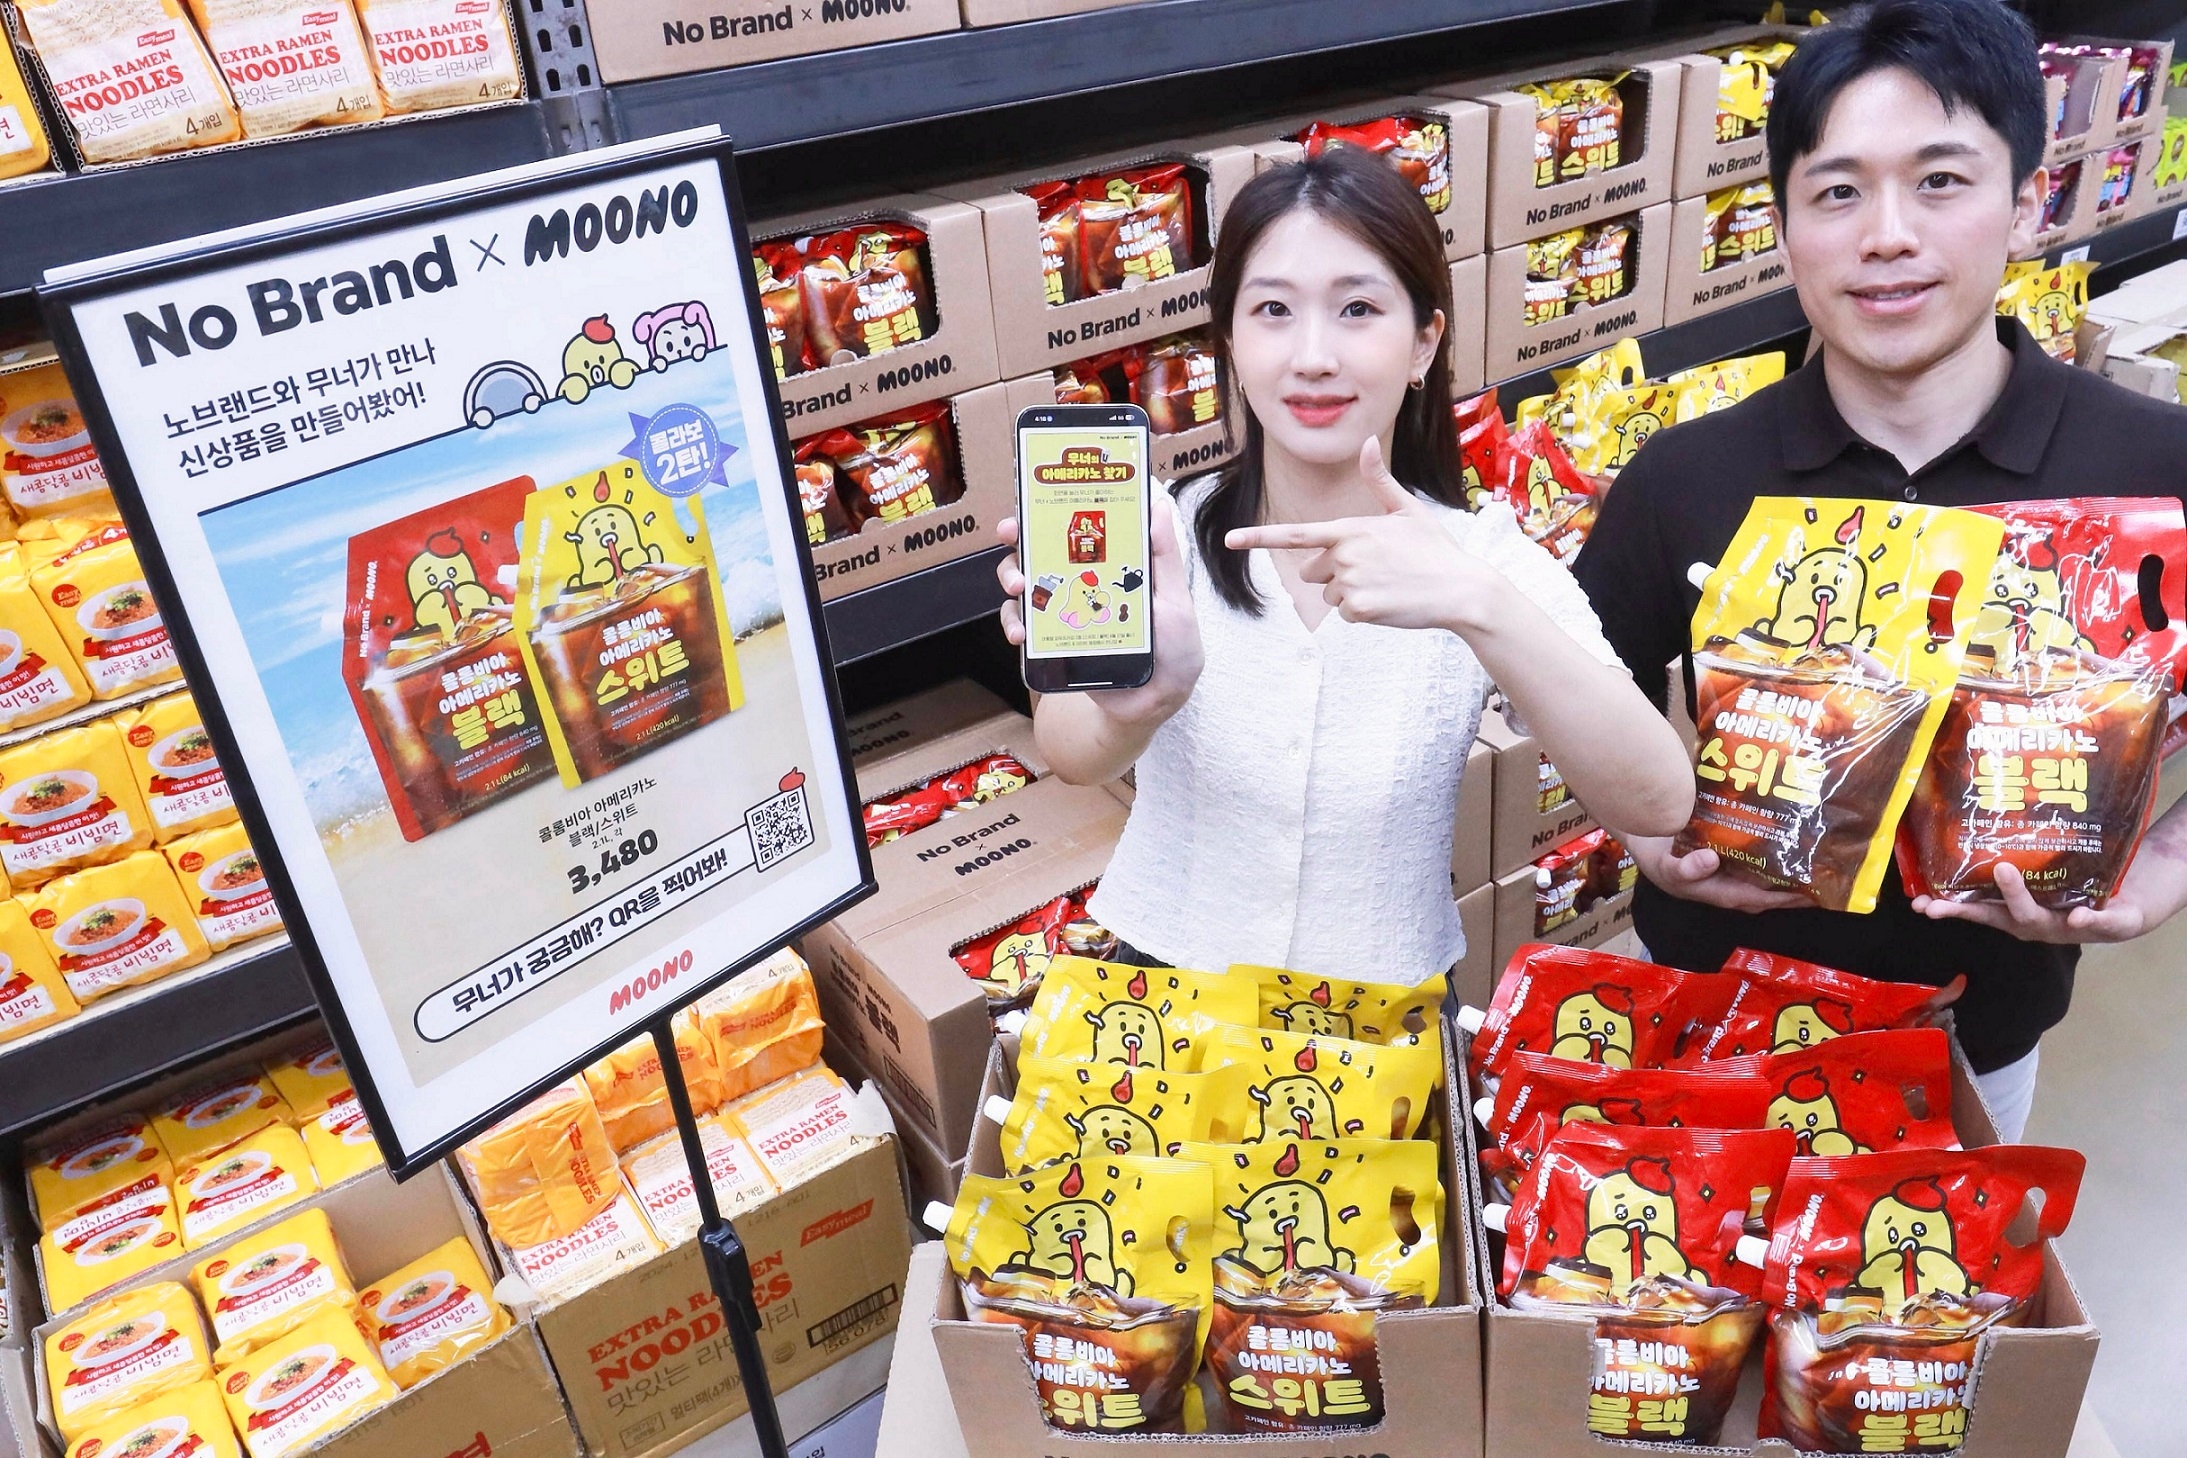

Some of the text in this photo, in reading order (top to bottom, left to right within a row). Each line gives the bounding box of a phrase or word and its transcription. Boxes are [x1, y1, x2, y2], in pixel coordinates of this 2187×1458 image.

[375, 19, 483, 45] EXTRA RAMEN
[663, 0, 907, 46] No Brand MOONO
[219, 30, 333, 64] EXTRA RAMEN
[225, 45, 341, 86] NOODLES
[380, 34, 489, 67] NOODLES
[54, 49, 173, 97] EXTRA RAMEN
[234, 67, 351, 109] 맛있는 라면사리
[385, 54, 495, 88] 맛있는 라면사리
[63, 65, 185, 119] NOODLES
[76, 86, 197, 140] 맛있는 라면사리
[1560, 143, 1620, 176] 스위트
[1707, 151, 1763, 177] No Brand
[1526, 178, 1646, 225] No Brand MOONO
[1719, 225, 1775, 255] 스위트
[123, 180, 698, 367] No Brand MOONO
[857, 271, 907, 303] 콜롬비아
[1572, 272, 1624, 300] 스위트
[1693, 275, 1746, 305] No Brand
[853, 290, 916, 322] 아메리카노
[1048, 287, 1211, 349] No Brand MOON
[864, 307, 922, 355] 블랙
[1518, 312, 1637, 361] No Brand MOONO
[163, 338, 436, 440] 노브랜드와 무너가 만나
[782, 354, 952, 419] Brand MOONO
[178, 381, 427, 480] 신상품을 만들어봤어!
[650, 418, 704, 447] 콜라보
[656, 443, 711, 486] 2탄!
[1042, 466, 1127, 481] 아메리카노 찾기
[1067, 452, 1099, 465] 무너의
[20, 474, 70, 493] 새콤달콤
[869, 468, 930, 504] 아메리카노
[815, 515, 975, 580] Brand MOONO
[359, 561, 377, 657] No Brand MOONO
[602, 608, 662, 646] 콜롬비아
[102, 656, 149, 677] 새콤달콤
[599, 627, 674, 667] 아메리카노
[439, 671, 522, 714] 아메리카노
[441, 652, 508, 693] 콜롬비아
[597, 639, 690, 706] 스위트
[452, 689, 525, 750] 블랙
[1735, 688, 1826, 727] 콜롬비아
[1715, 711, 1822, 752] 아메리카노
[1967, 728, 2099, 752] 아메리카노
[1697, 737, 1827, 806] 스위트
[1972, 756, 2089, 813] 블랙
[163, 794, 210, 813] 새콤달콤
[538, 777, 658, 843] 콜롬비아 아메리카노
[13, 820, 122, 861] 새콤달콤 비빔면
[568, 803, 639, 848] 블랙/스위트
[614, 828, 623, 839] 각
[917, 813, 1020, 862] No Brand
[1532, 830, 1553, 848] No
[2072, 822, 2087, 830] 840
[2089, 824, 2101, 832] mg
[568, 829, 659, 895] 3,480
[954, 838, 1032, 876] MOONO
[2043, 868, 2067, 881] kcal)
[213, 914, 257, 934] 새콤달콤
[452, 849, 728, 1014] 무너가 궁금해? QR을 찍어봐!
[77, 938, 174, 987] 새콤달콤 비빔면
[609, 949, 694, 1015] MOONO
[1489, 1026, 1510, 1060] Brand
[1511, 976, 1533, 1017] MOONO
[1508, 1085, 1533, 1124] MOONO
[757, 1104, 839, 1151] EXTRA RAMEN
[764, 1110, 848, 1160] NOODLES
[772, 1146, 812, 1168] 맛있는
[1537, 1152, 1558, 1200] MOONO
[238, 1182, 287, 1208] 비빔면
[644, 1179, 688, 1202] EXTRA
[654, 1200, 695, 1222] 맛있는
[735, 1185, 766, 1203] 4개입
[1801, 1193, 1825, 1242] MOONO
[525, 1221, 619, 1275] NOODLES
[530, 1233, 627, 1286] 맛있는 라면사리
[271, 1275, 325, 1305] 비빔면
[587, 1305, 684, 1365] EXTRA
[688, 1250, 784, 1313] RAEN
[390, 1302, 478, 1355] 새콤달콤 비빔면
[596, 1272, 793, 1392] NOODES
[1247, 1325, 1337, 1353] 콜롬비아
[126, 1346, 181, 1375] 비빔면
[1033, 1333, 1117, 1369] 콜롬비아
[1238, 1349, 1352, 1376] 아메리카노
[1601, 1339, 1690, 1369] 콜롬비아
[1868, 1357, 1967, 1386] 콜롬비아
[608, 1363, 689, 1417] 맛있는
[1229, 1374, 1372, 1417] 스위트
[262, 1377, 365, 1446] 새콤달콤 비빔면
[1589, 1394, 1688, 1436] 블랙
[1860, 1409, 1967, 1453] 블랙
